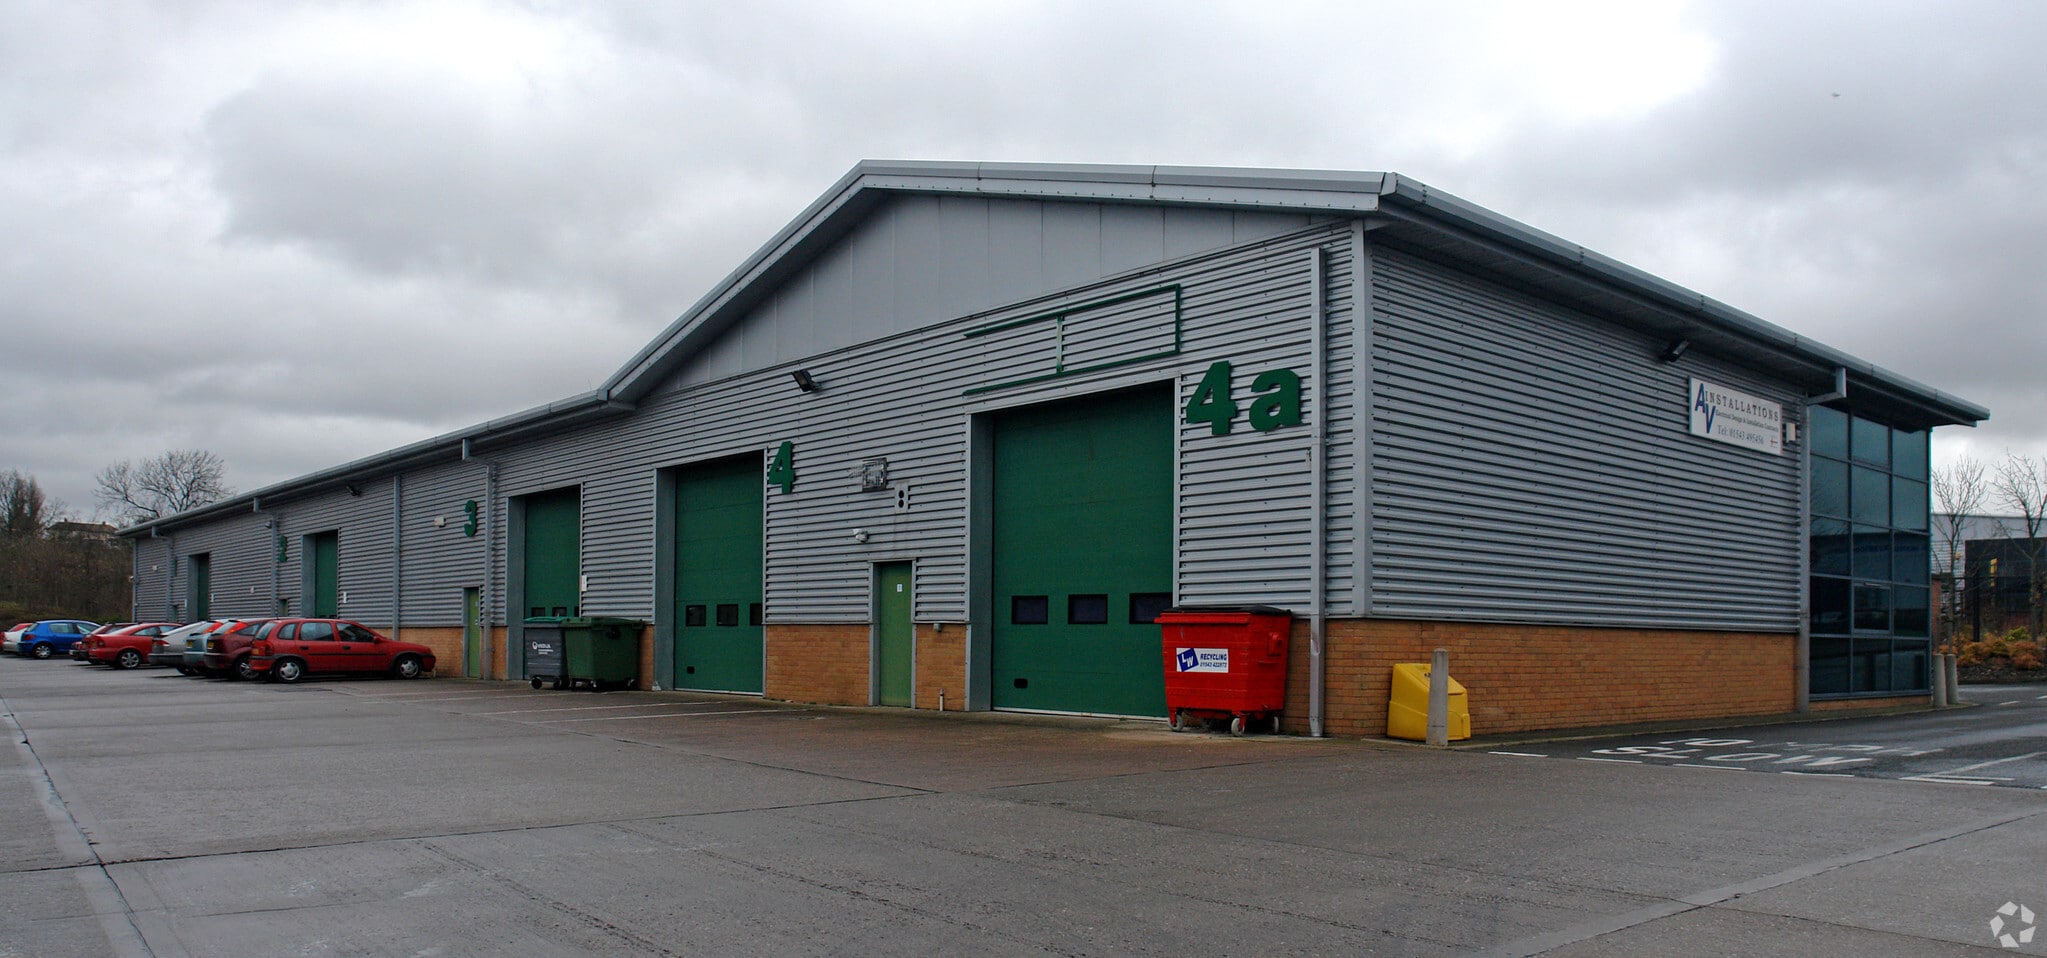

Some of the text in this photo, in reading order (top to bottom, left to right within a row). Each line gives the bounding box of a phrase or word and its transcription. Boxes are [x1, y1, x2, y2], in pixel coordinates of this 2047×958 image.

[1186, 360, 1302, 436] 4a
[1705, 390, 1779, 422] INSTALLATIONS
[769, 441, 795, 494] 4
[464, 500, 477, 537] 3
[1200, 653, 1227, 661] RECYCLING
[1591, 746, 1873, 767] SLOW
